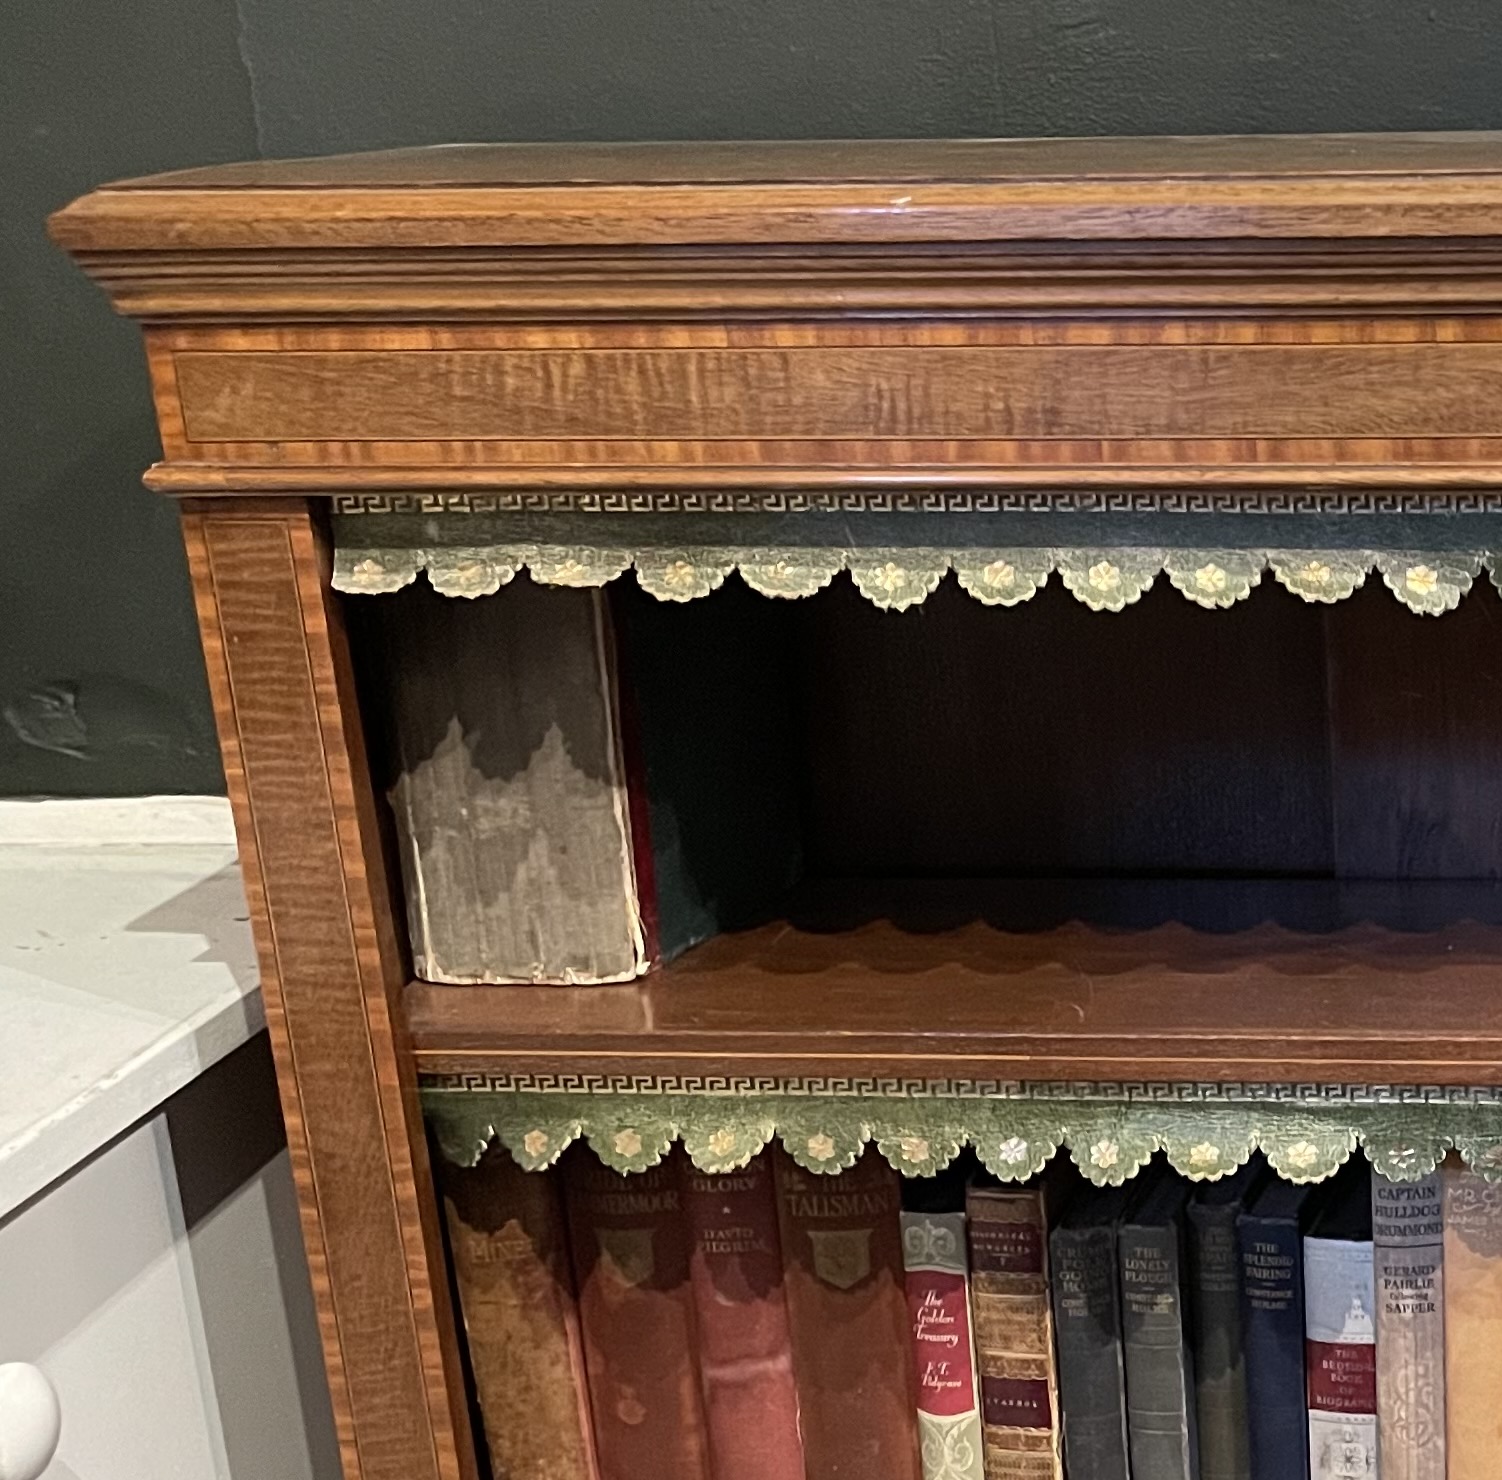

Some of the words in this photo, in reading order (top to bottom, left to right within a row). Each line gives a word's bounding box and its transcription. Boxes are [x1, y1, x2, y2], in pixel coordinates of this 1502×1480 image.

[692, 1177, 757, 1193] GLORY
[1378, 1186, 1436, 1200] CAPTAIN
[1447, 1187, 1477, 1203] MR
[785, 1193, 890, 1217] TALISMAN
[1375, 1204, 1441, 1218] BULLDOG
[704, 1227, 754, 1240] DAVID
[1375, 1222, 1443, 1237] DRUMMOND
[1134, 1246, 1162, 1258] THE
[1252, 1242, 1279, 1254] THE
[1124, 1257, 1171, 1271] LONELY
[1243, 1253, 1294, 1267] SPLENDID
[1124, 1270, 1173, 1283] PLOUGH
[1245, 1267, 1291, 1280] FAIRING
[1384, 1265, 1436, 1276] GERARD
[1384, 1279, 1435, 1289] FAIRLIE
[923, 1289, 944, 1307] The
[1385, 1302, 1436, 1313] SAPPER
[916, 1307, 956, 1324] Golden
[913, 1324, 959, 1349] Treasury
[1335, 1349, 1358, 1359] THE
[1331, 1372, 1363, 1384] BOOK
